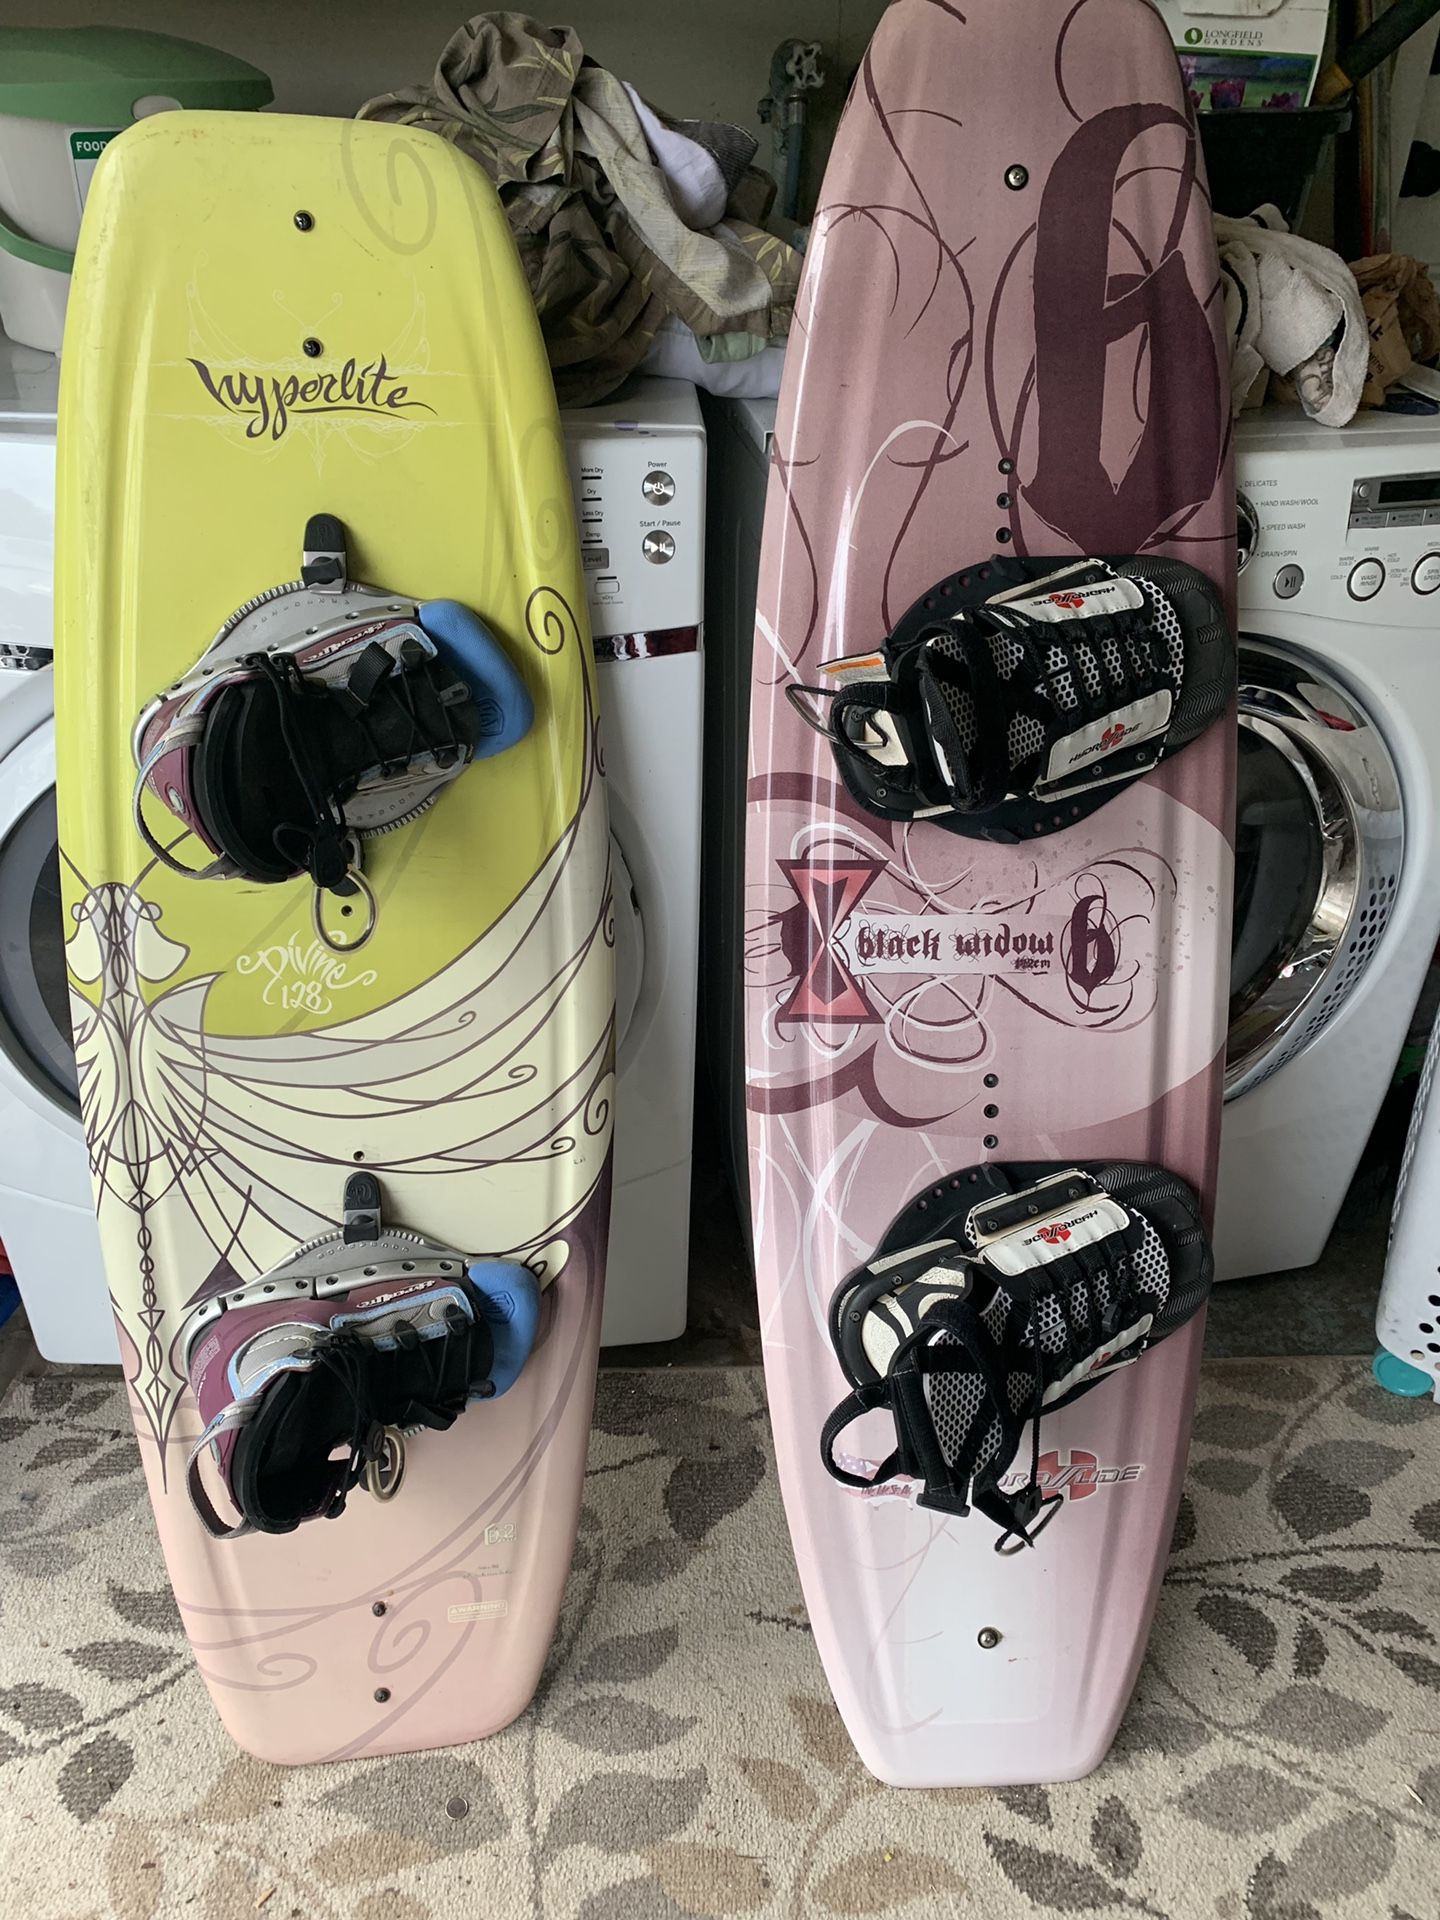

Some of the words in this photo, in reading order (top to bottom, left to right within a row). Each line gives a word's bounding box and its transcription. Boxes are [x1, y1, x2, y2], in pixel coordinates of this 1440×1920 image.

[1205, 30, 1263, 39] LONGFIELD
[1204, 39, 1262, 47] GARDENS
[1244, 480, 1278, 488] DELICATES
[1266, 523, 1286, 531] SPEED
[1287, 522, 1306, 530] WASH
[856, 919, 942, 966] black
[955, 922, 1056, 959] widow
[281, 980, 333, 1014] 128
